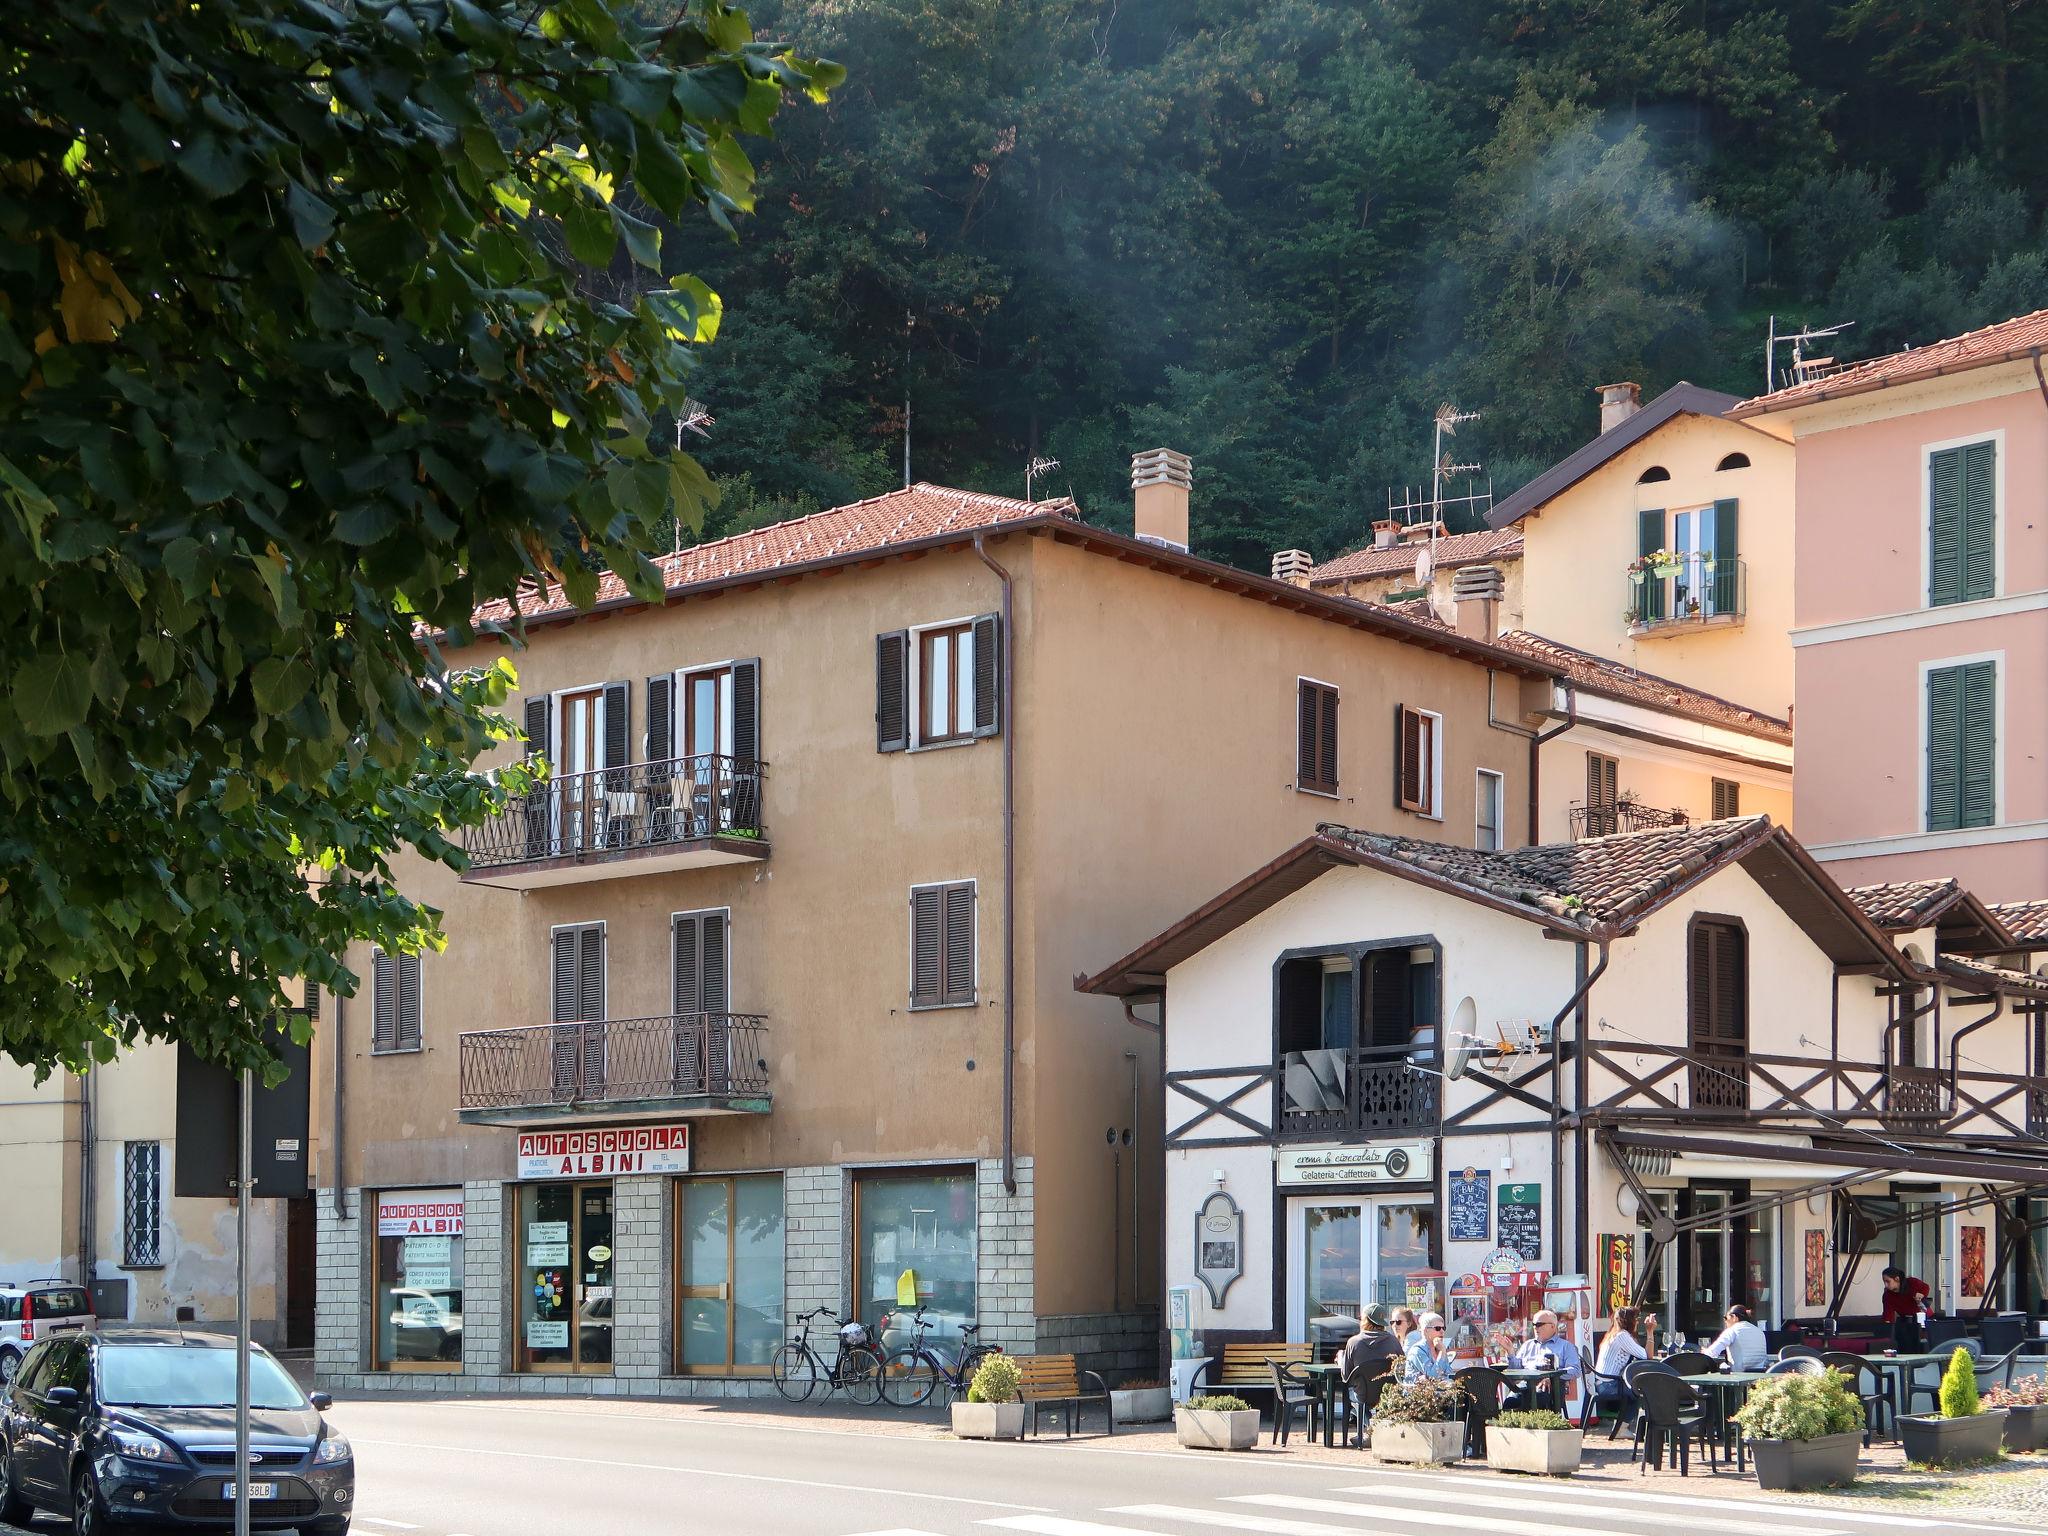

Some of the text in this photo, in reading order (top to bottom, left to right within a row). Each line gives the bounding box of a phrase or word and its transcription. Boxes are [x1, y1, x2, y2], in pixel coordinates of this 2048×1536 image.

[520, 1130, 685, 1155] AUTOSCUOLA
[1335, 1149, 1381, 1163] cioccolato
[560, 1153, 643, 1174] ALBINI
[380, 1205, 463, 1217] AUTOSCUOL
[231, 1485, 270, 1496] E38LB
